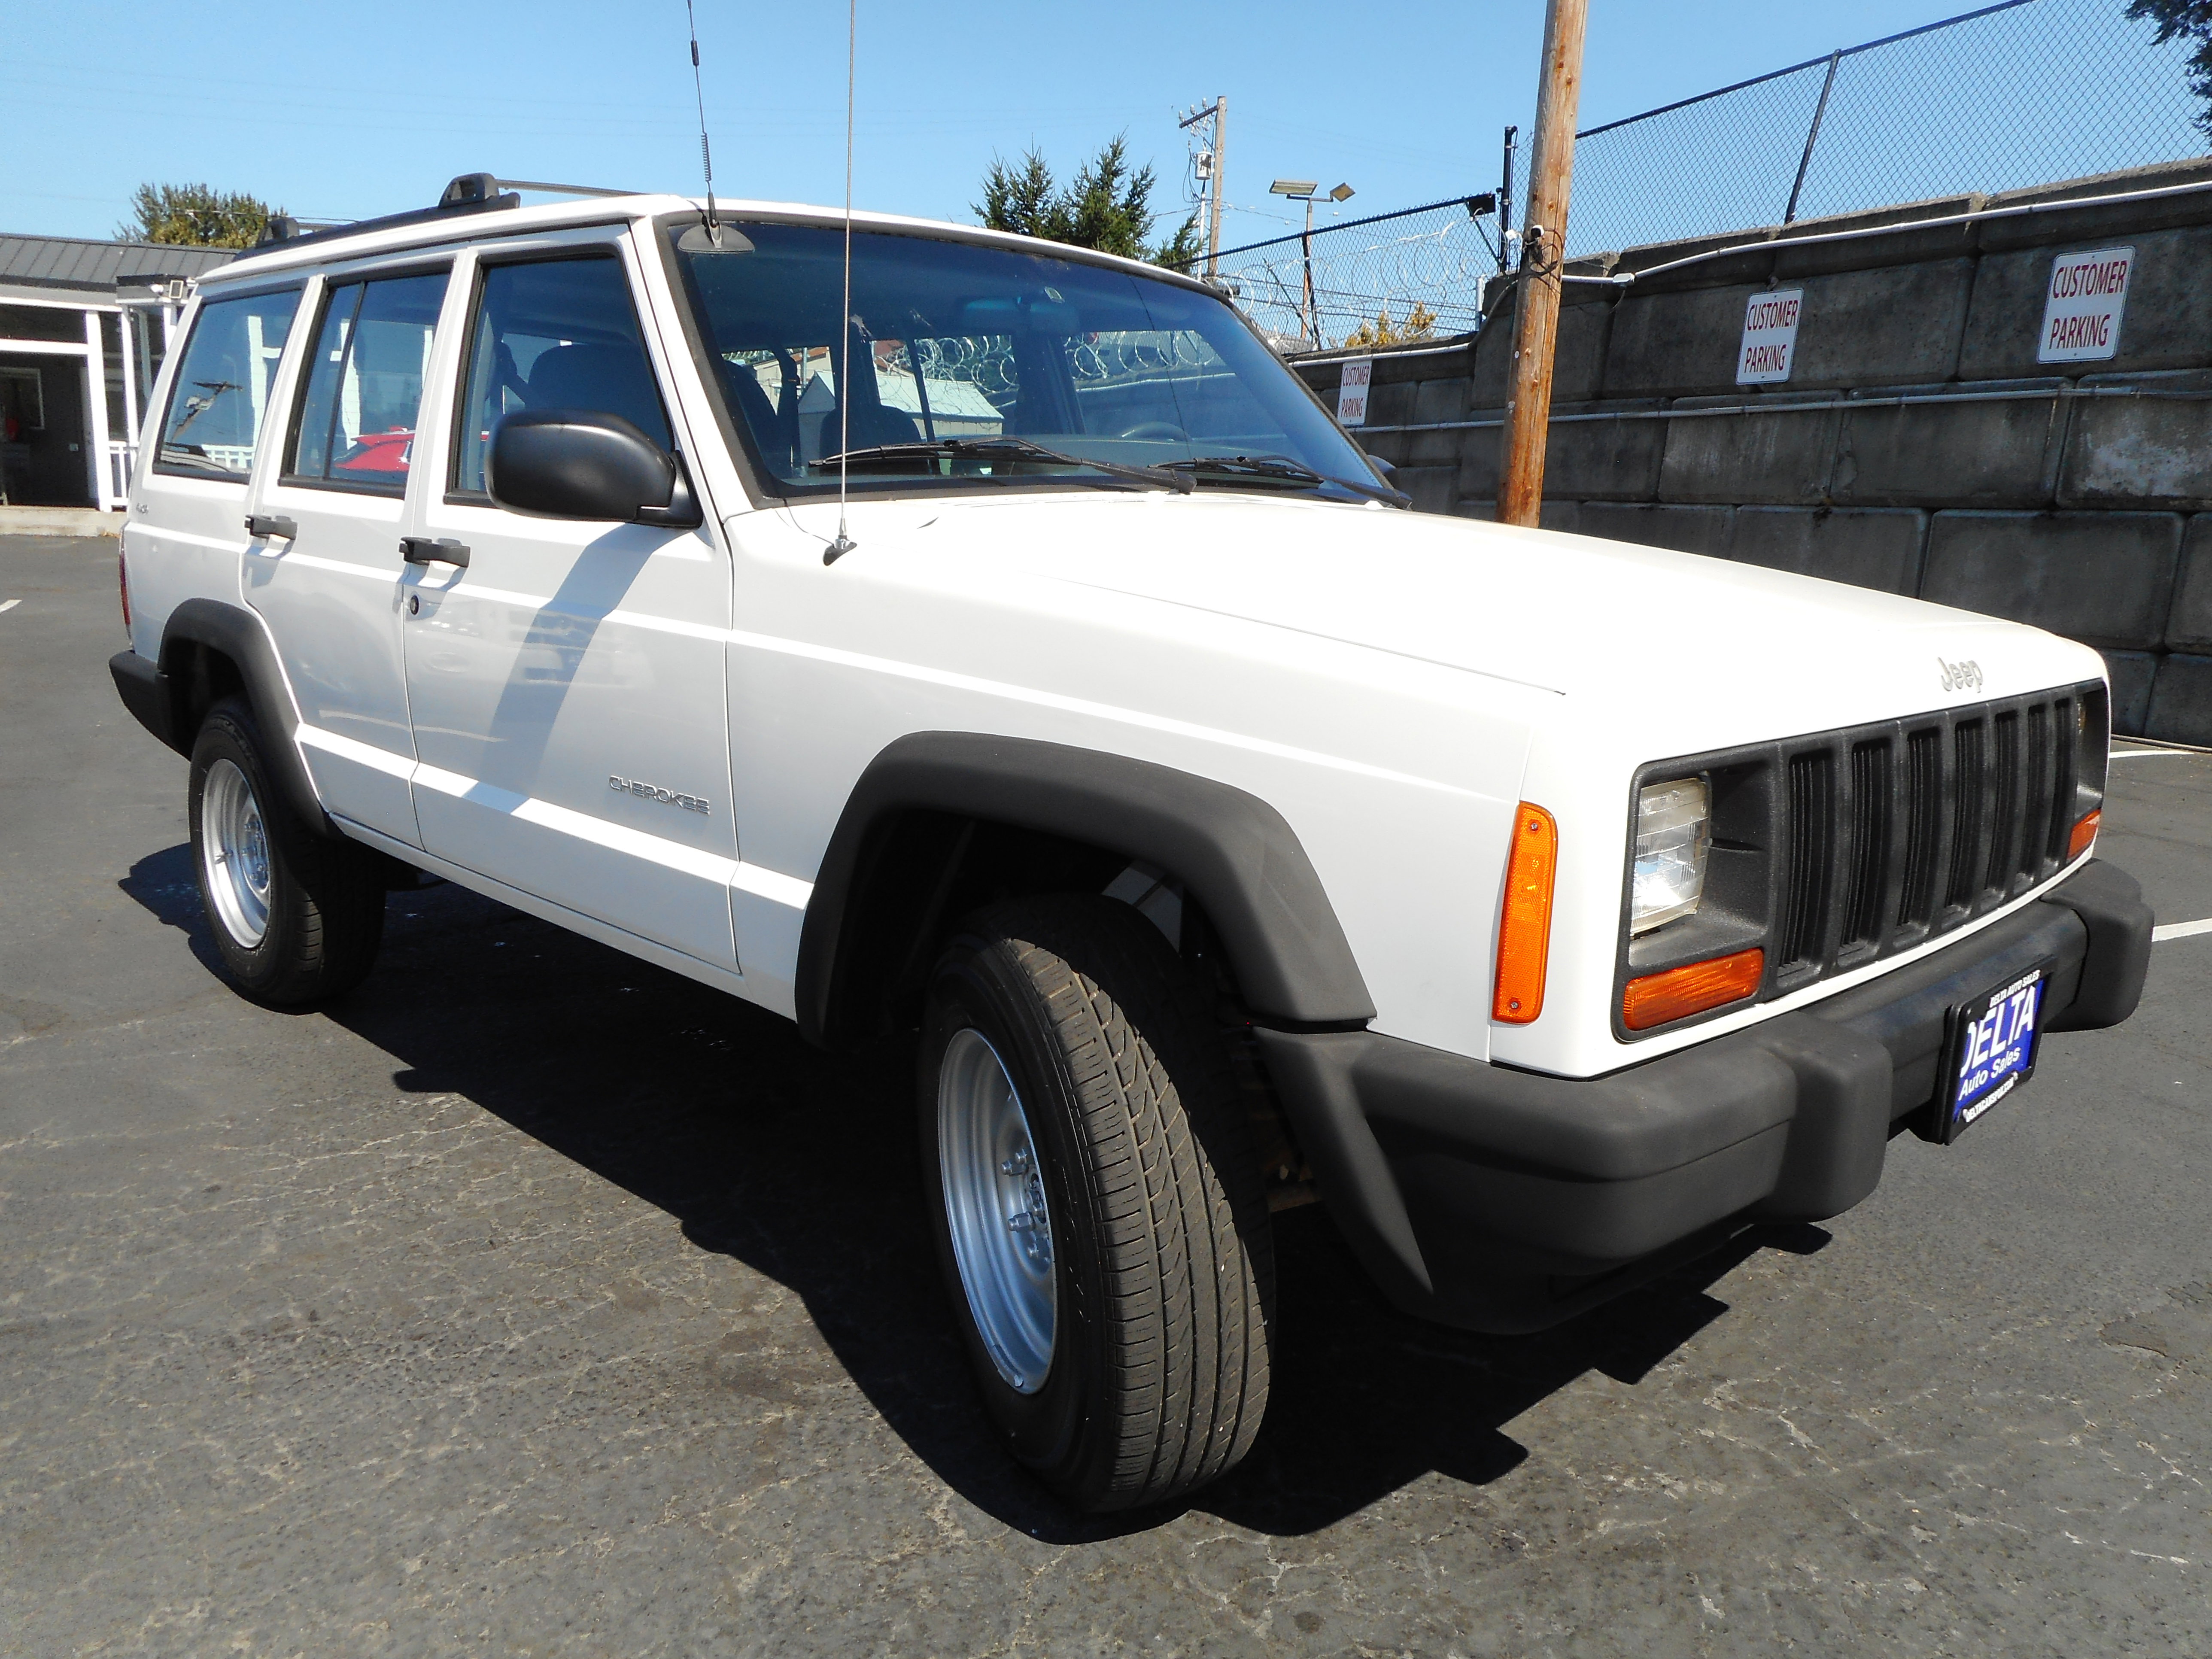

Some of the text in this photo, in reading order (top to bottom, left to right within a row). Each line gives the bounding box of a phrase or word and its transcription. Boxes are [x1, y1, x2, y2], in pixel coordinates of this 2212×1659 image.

[2052, 259, 2127, 299] CUSTOMER
[1746, 299, 1799, 331] CUSTOMER
[2048, 313, 2111, 350] PARKING
[1343, 366, 1370, 386] CUSTOMER
[1744, 344, 1787, 374] PARKING
[1341, 397, 1363, 418] PARKING
[1937, 657, 1983, 693] Jeep
[608, 775, 711, 815] CHEROKEE
[1989, 970, 2041, 1008] DELTA AUTO SALES
[1958, 1047, 2021, 1101] Auto Sales
